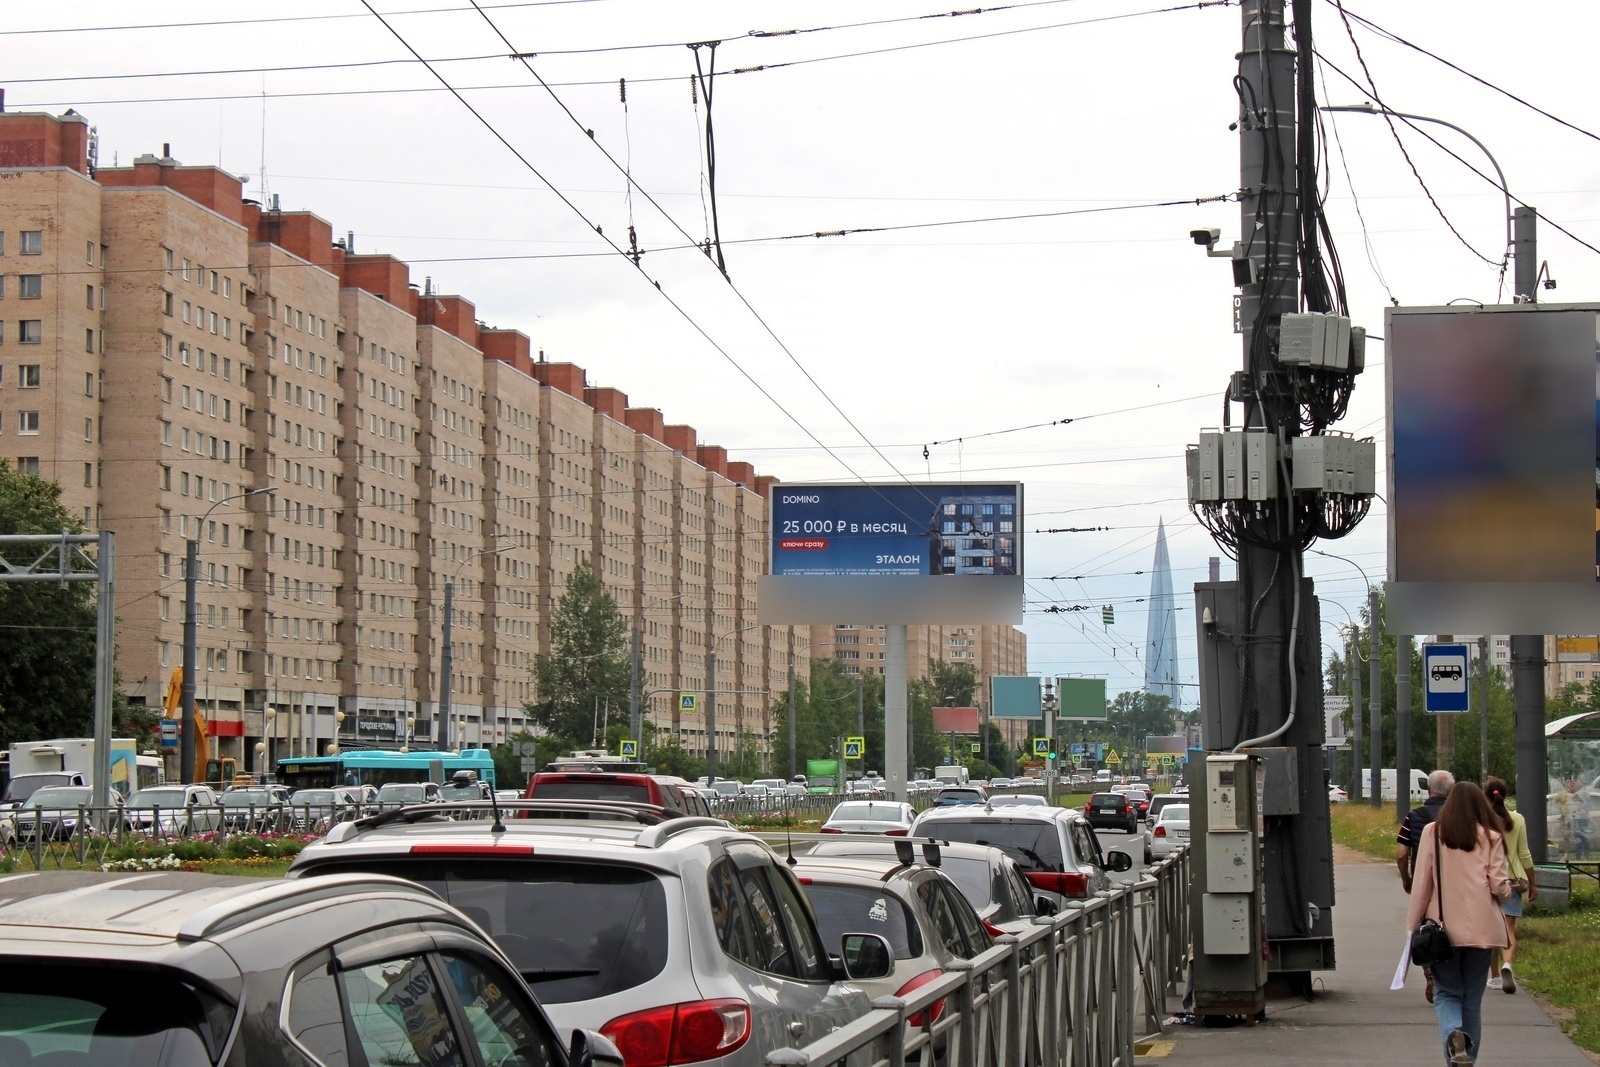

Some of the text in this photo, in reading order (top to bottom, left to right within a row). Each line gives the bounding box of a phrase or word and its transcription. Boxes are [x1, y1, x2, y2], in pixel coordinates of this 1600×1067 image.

[782, 495, 820, 504] DOMINO
[783, 520, 907, 535] 25 000 ₽ в месяц
[804, 541, 824, 549] сразу
[876, 555, 920, 564] ЭТАЛОН
